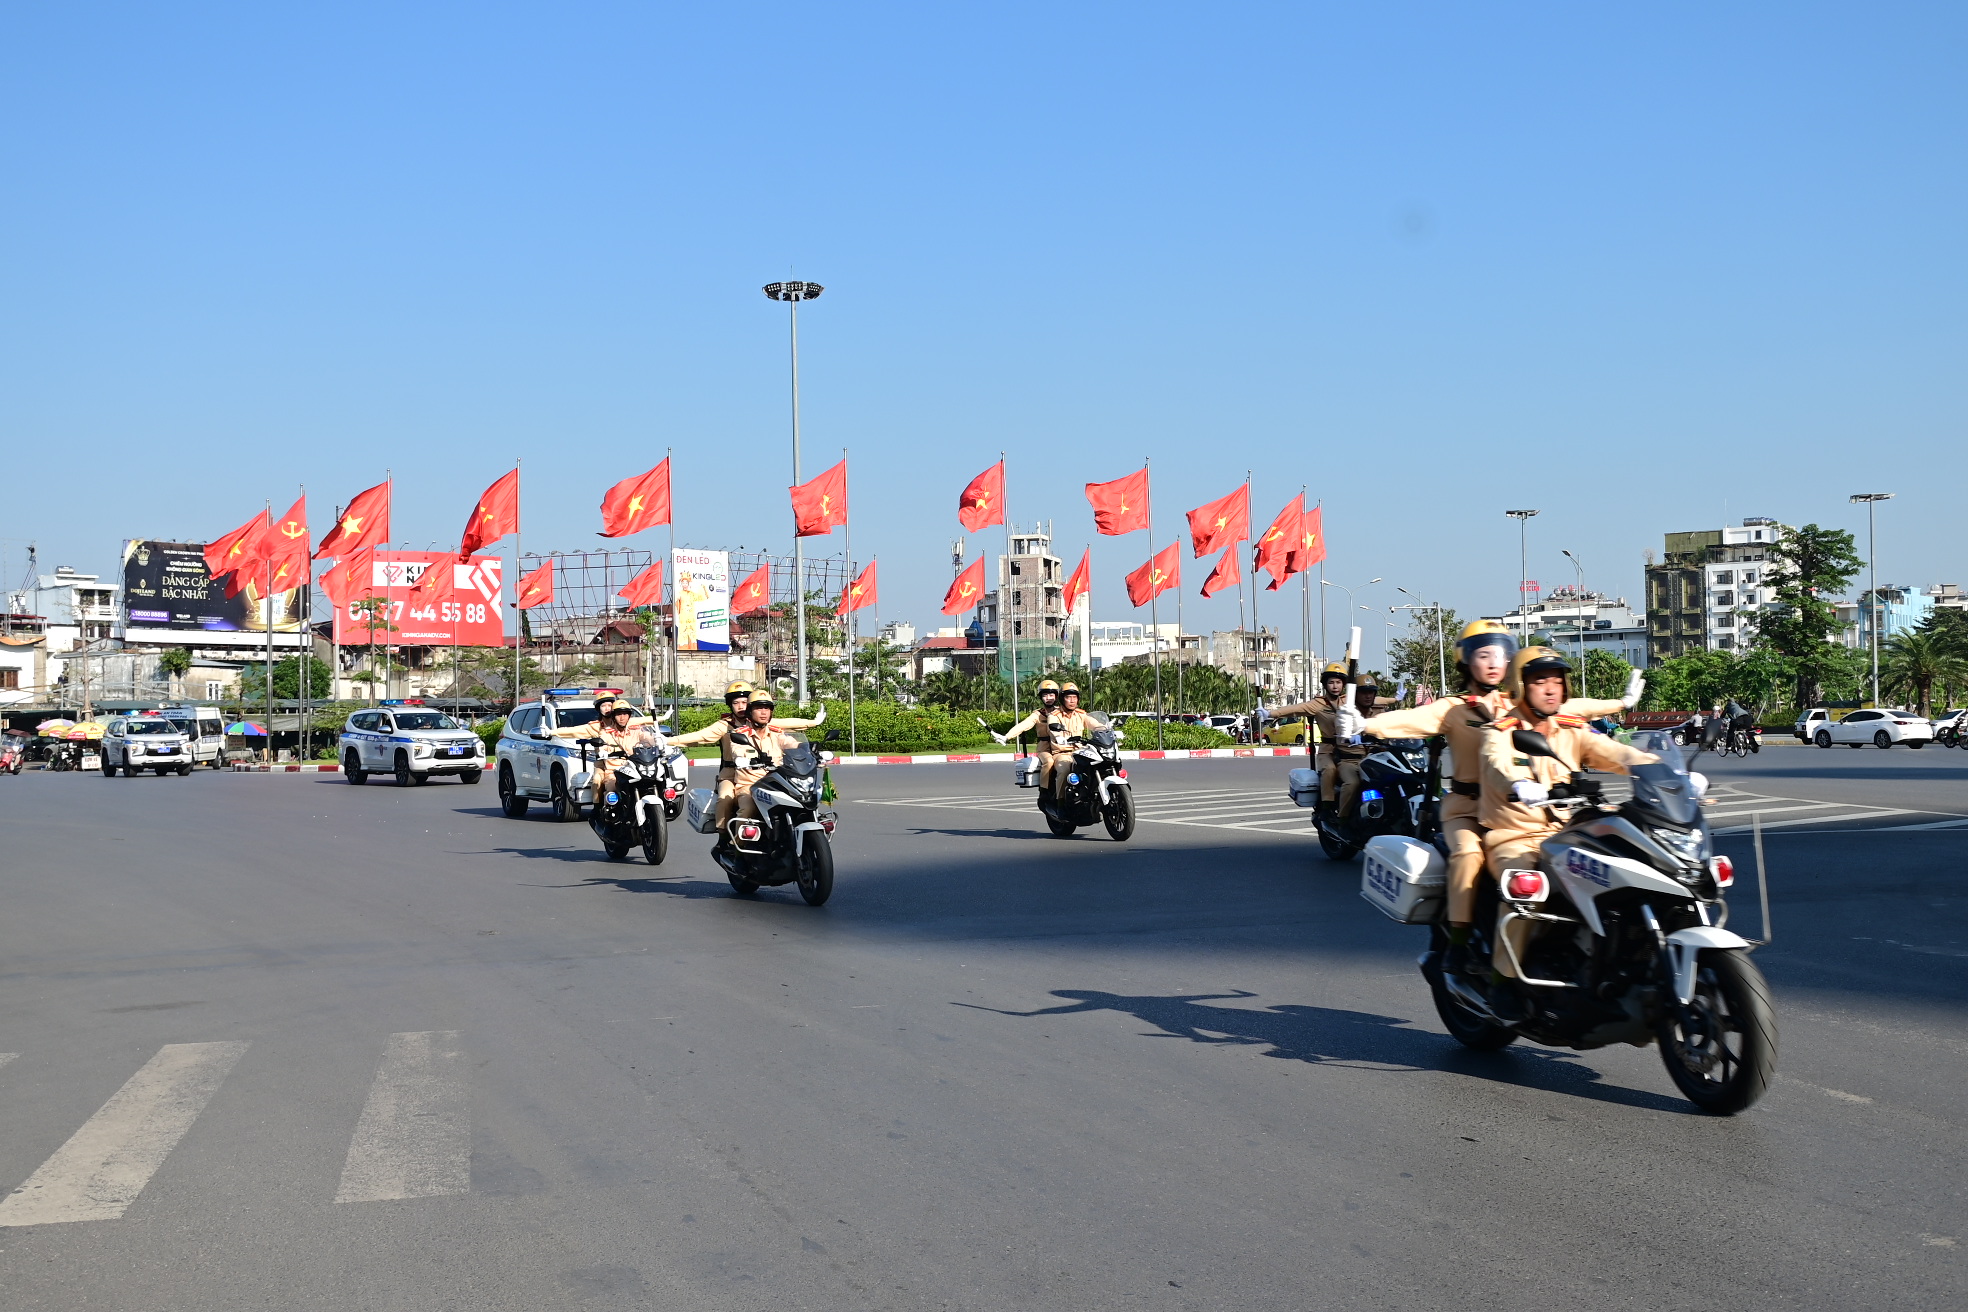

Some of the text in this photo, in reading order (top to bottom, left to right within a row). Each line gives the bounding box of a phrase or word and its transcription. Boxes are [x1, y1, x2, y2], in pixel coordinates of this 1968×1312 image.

[162, 572, 210, 588] ĐẲNG CẤP
[692, 572, 727, 582] KINGLED
[162, 586, 208, 600] BẬC NHẤT
[465, 602, 486, 623] 88
